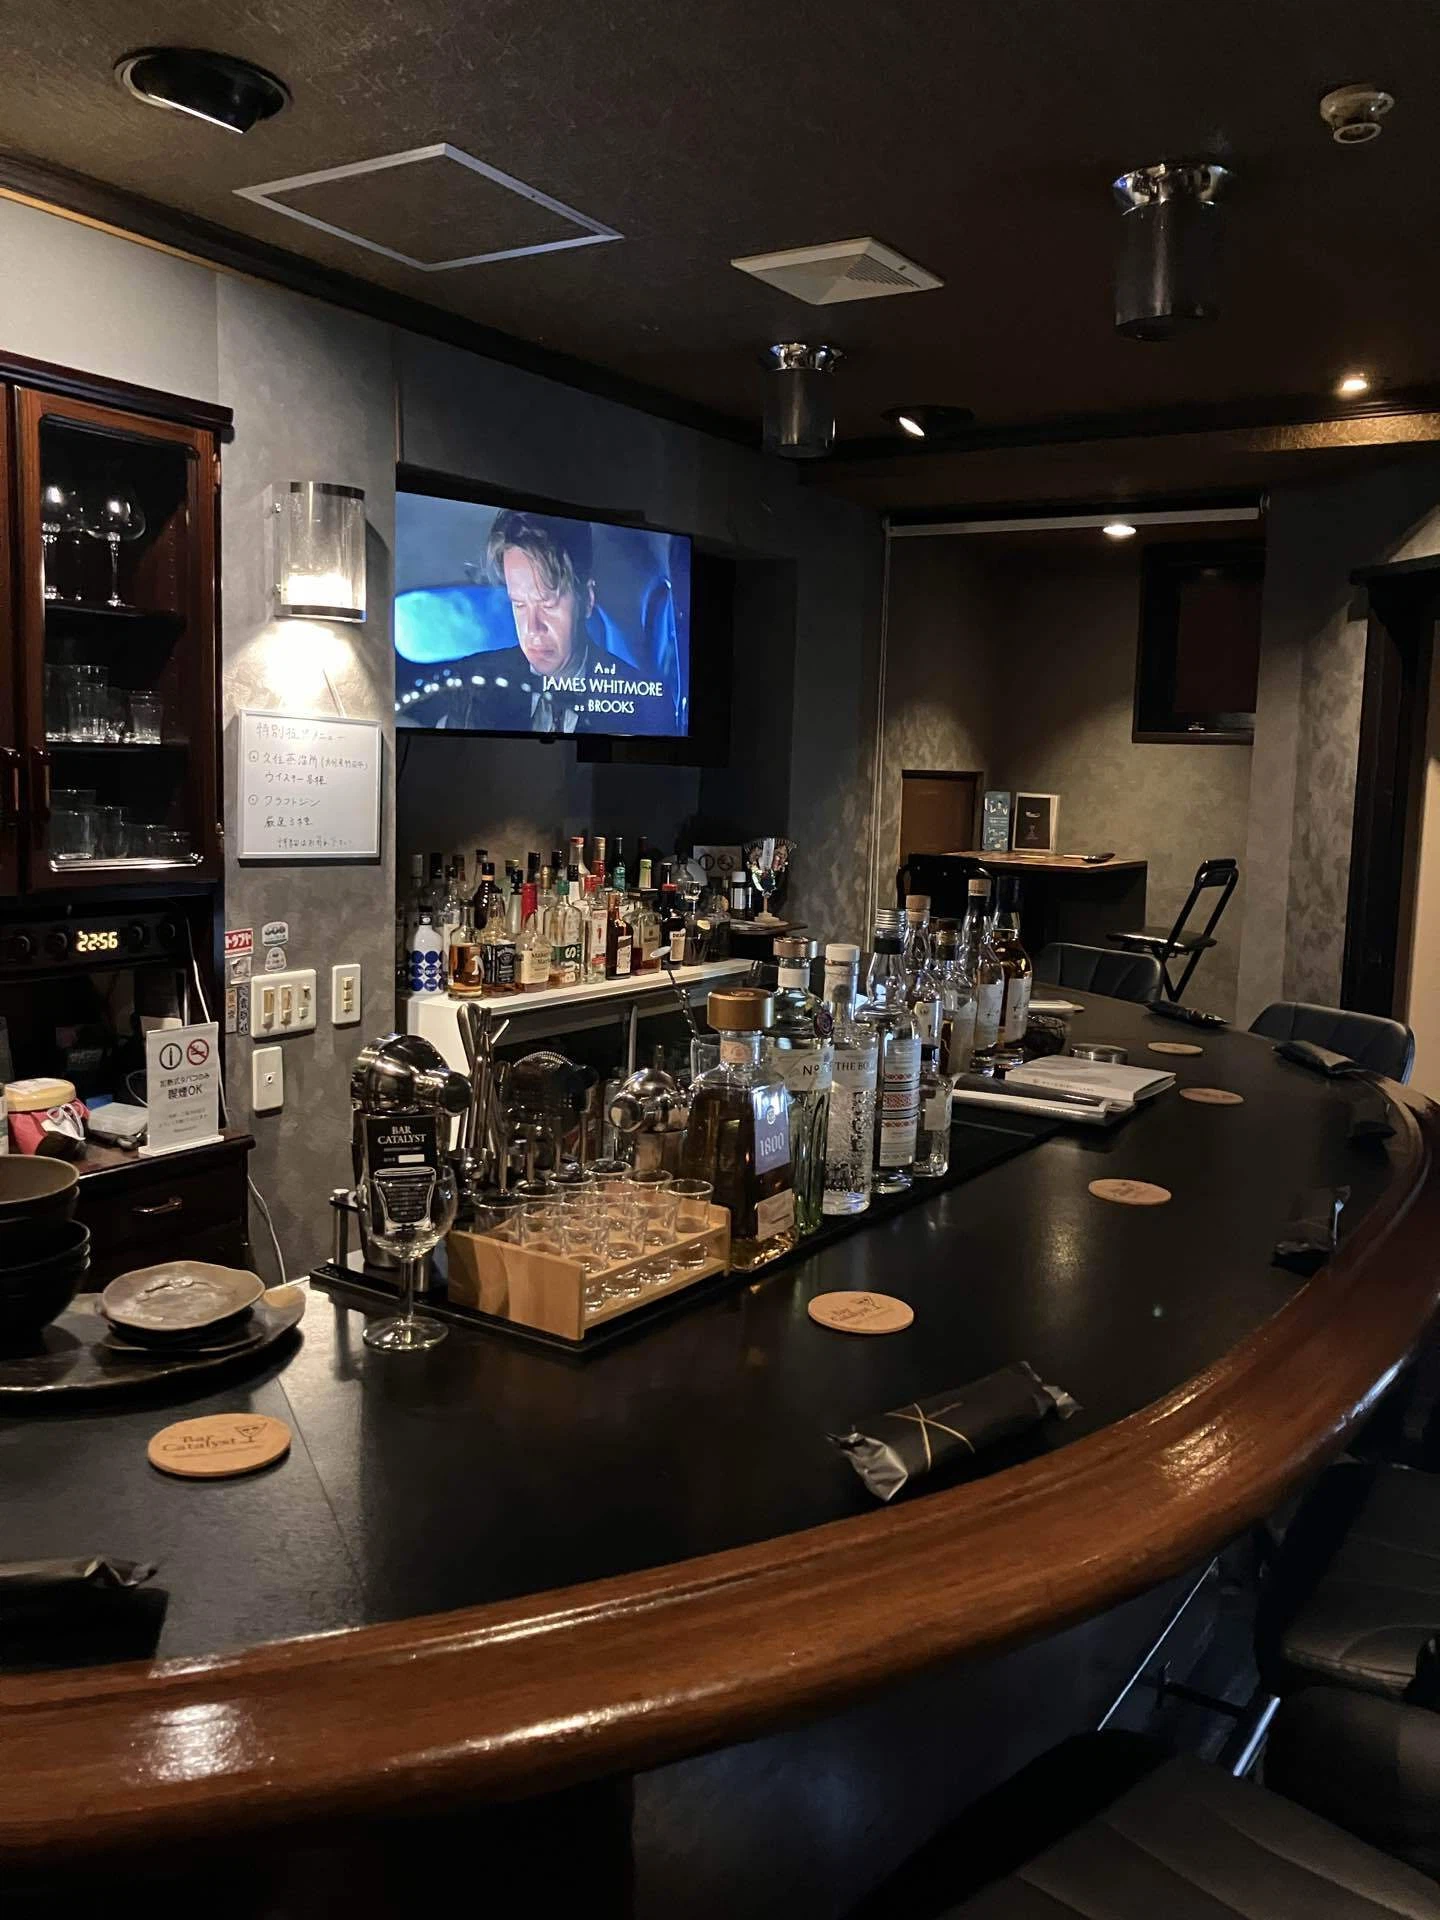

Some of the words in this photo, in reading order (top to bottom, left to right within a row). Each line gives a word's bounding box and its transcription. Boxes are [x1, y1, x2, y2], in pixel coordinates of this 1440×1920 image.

[594, 662, 616, 675] And
[543, 676, 587, 692] JAMES
[589, 679, 663, 696] WHITMORE
[574, 704, 585, 712] as
[588, 699, 635, 714] BROOKS
[77, 930, 118, 952] 22:56
[834, 1061, 856, 1071] THE
[392, 1126, 412, 1134] BAR
[377, 1134, 426, 1144] CATALYST
[760, 1133, 785, 1156] 1800
[162, 1438, 236, 1450] Catalyst
